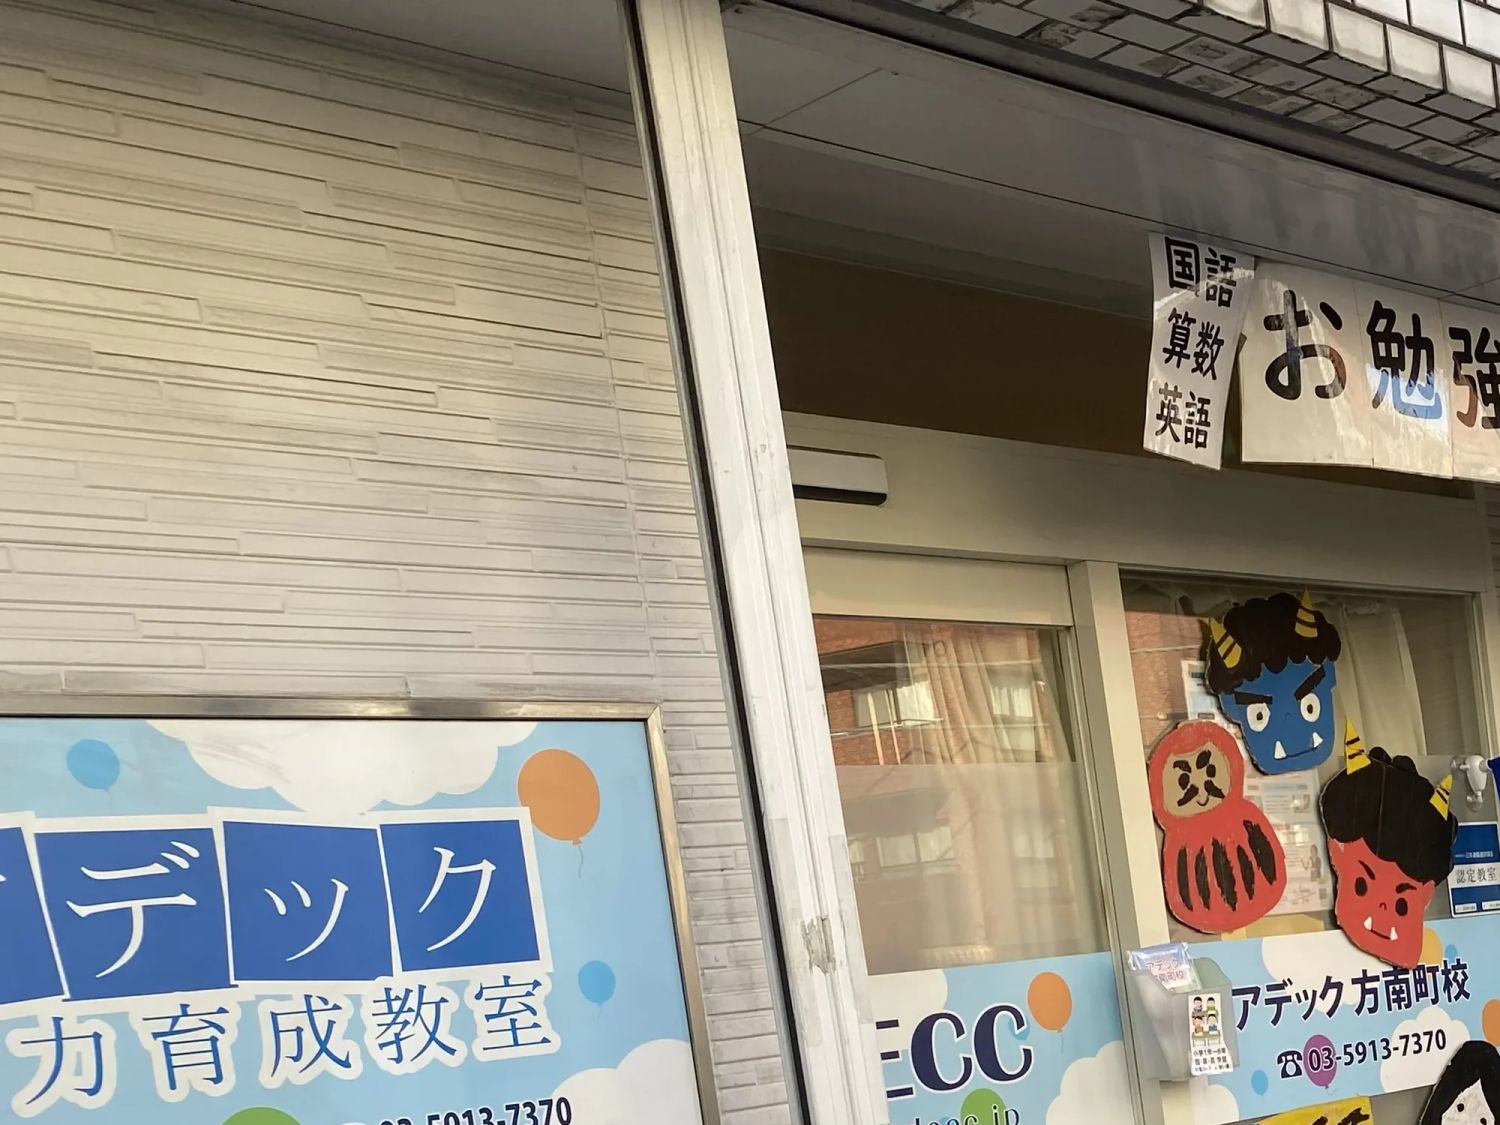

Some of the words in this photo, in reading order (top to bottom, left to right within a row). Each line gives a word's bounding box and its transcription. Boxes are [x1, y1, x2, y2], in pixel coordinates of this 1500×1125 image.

[1165, 236, 1236, 308] 国語
[1162, 307, 1226, 381] 算数
[1156, 382, 1212, 449] 英語
[0, 839, 497, 978] デック
[1456, 866, 1497, 884] 認定教室
[20, 975, 553, 1106] 力育成教室
[1309, 1029, 1446, 1072] 03-5913-7370
